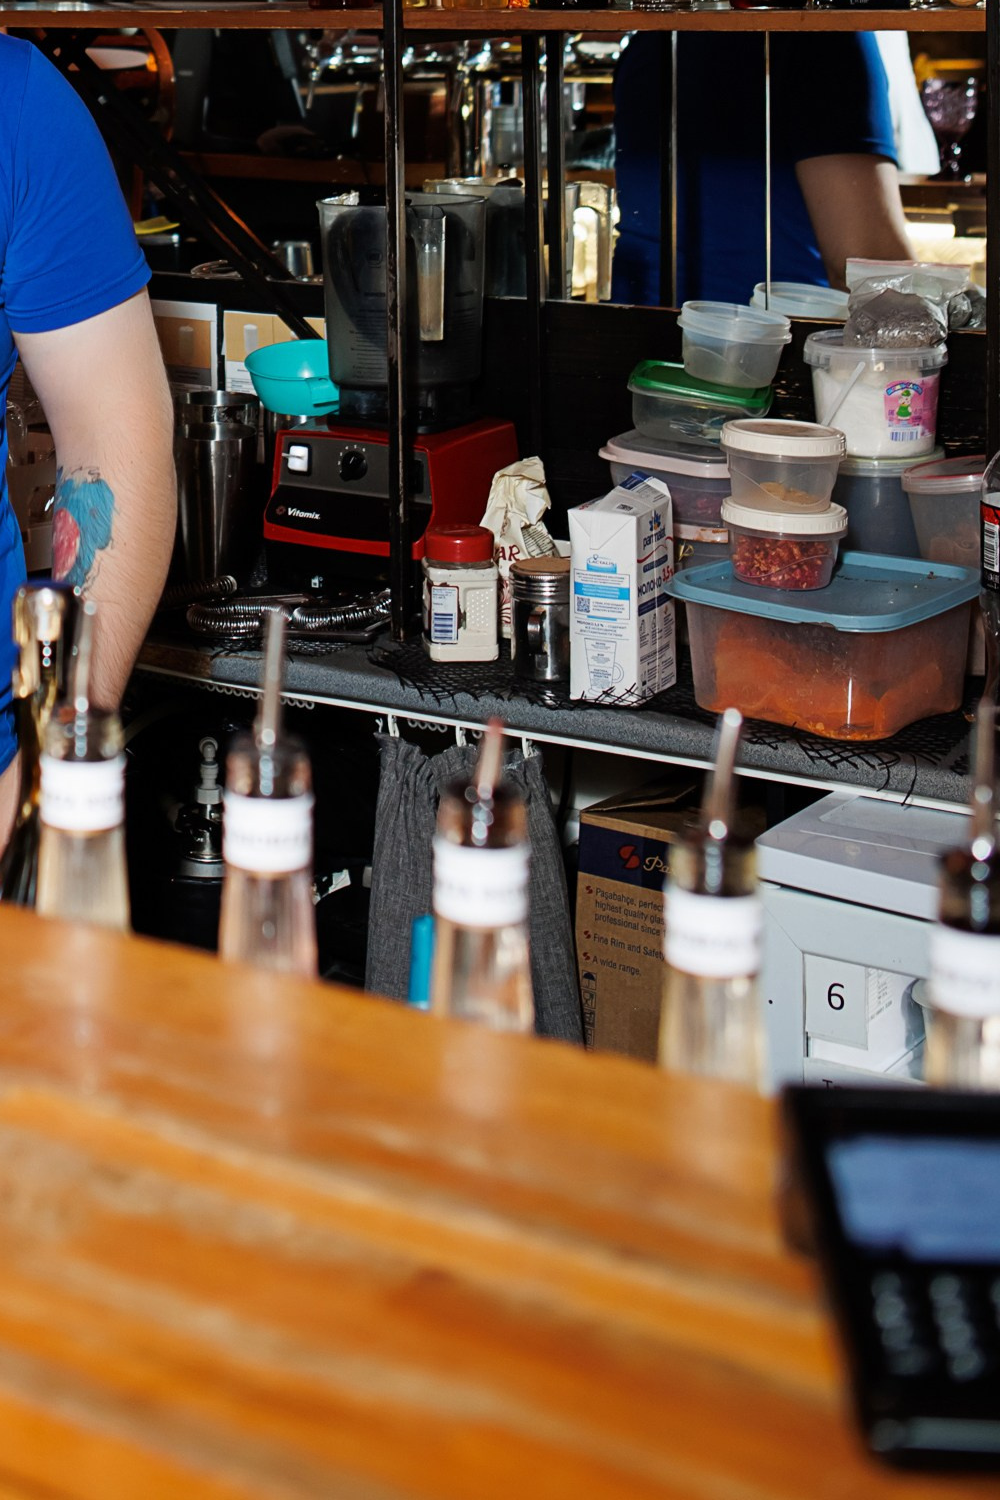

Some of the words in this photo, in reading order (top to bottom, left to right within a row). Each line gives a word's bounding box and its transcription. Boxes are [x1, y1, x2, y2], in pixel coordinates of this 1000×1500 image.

[287, 507, 320, 520] Vitamix
[588, 559, 616, 567] LACTALIS
[595, 900, 622, 914] highest
[624, 909, 649, 922] quality
[595, 913, 639, 930] professional
[641, 923, 660, 936] since
[593, 933, 608, 945] Fine
[610, 938, 625, 949] Rim
[627, 943, 641, 953] and
[643, 945, 665, 960] Safety
[592, 956, 598, 964] A
[600, 958, 617, 970] wide
[827, 982, 845, 1011] 6
